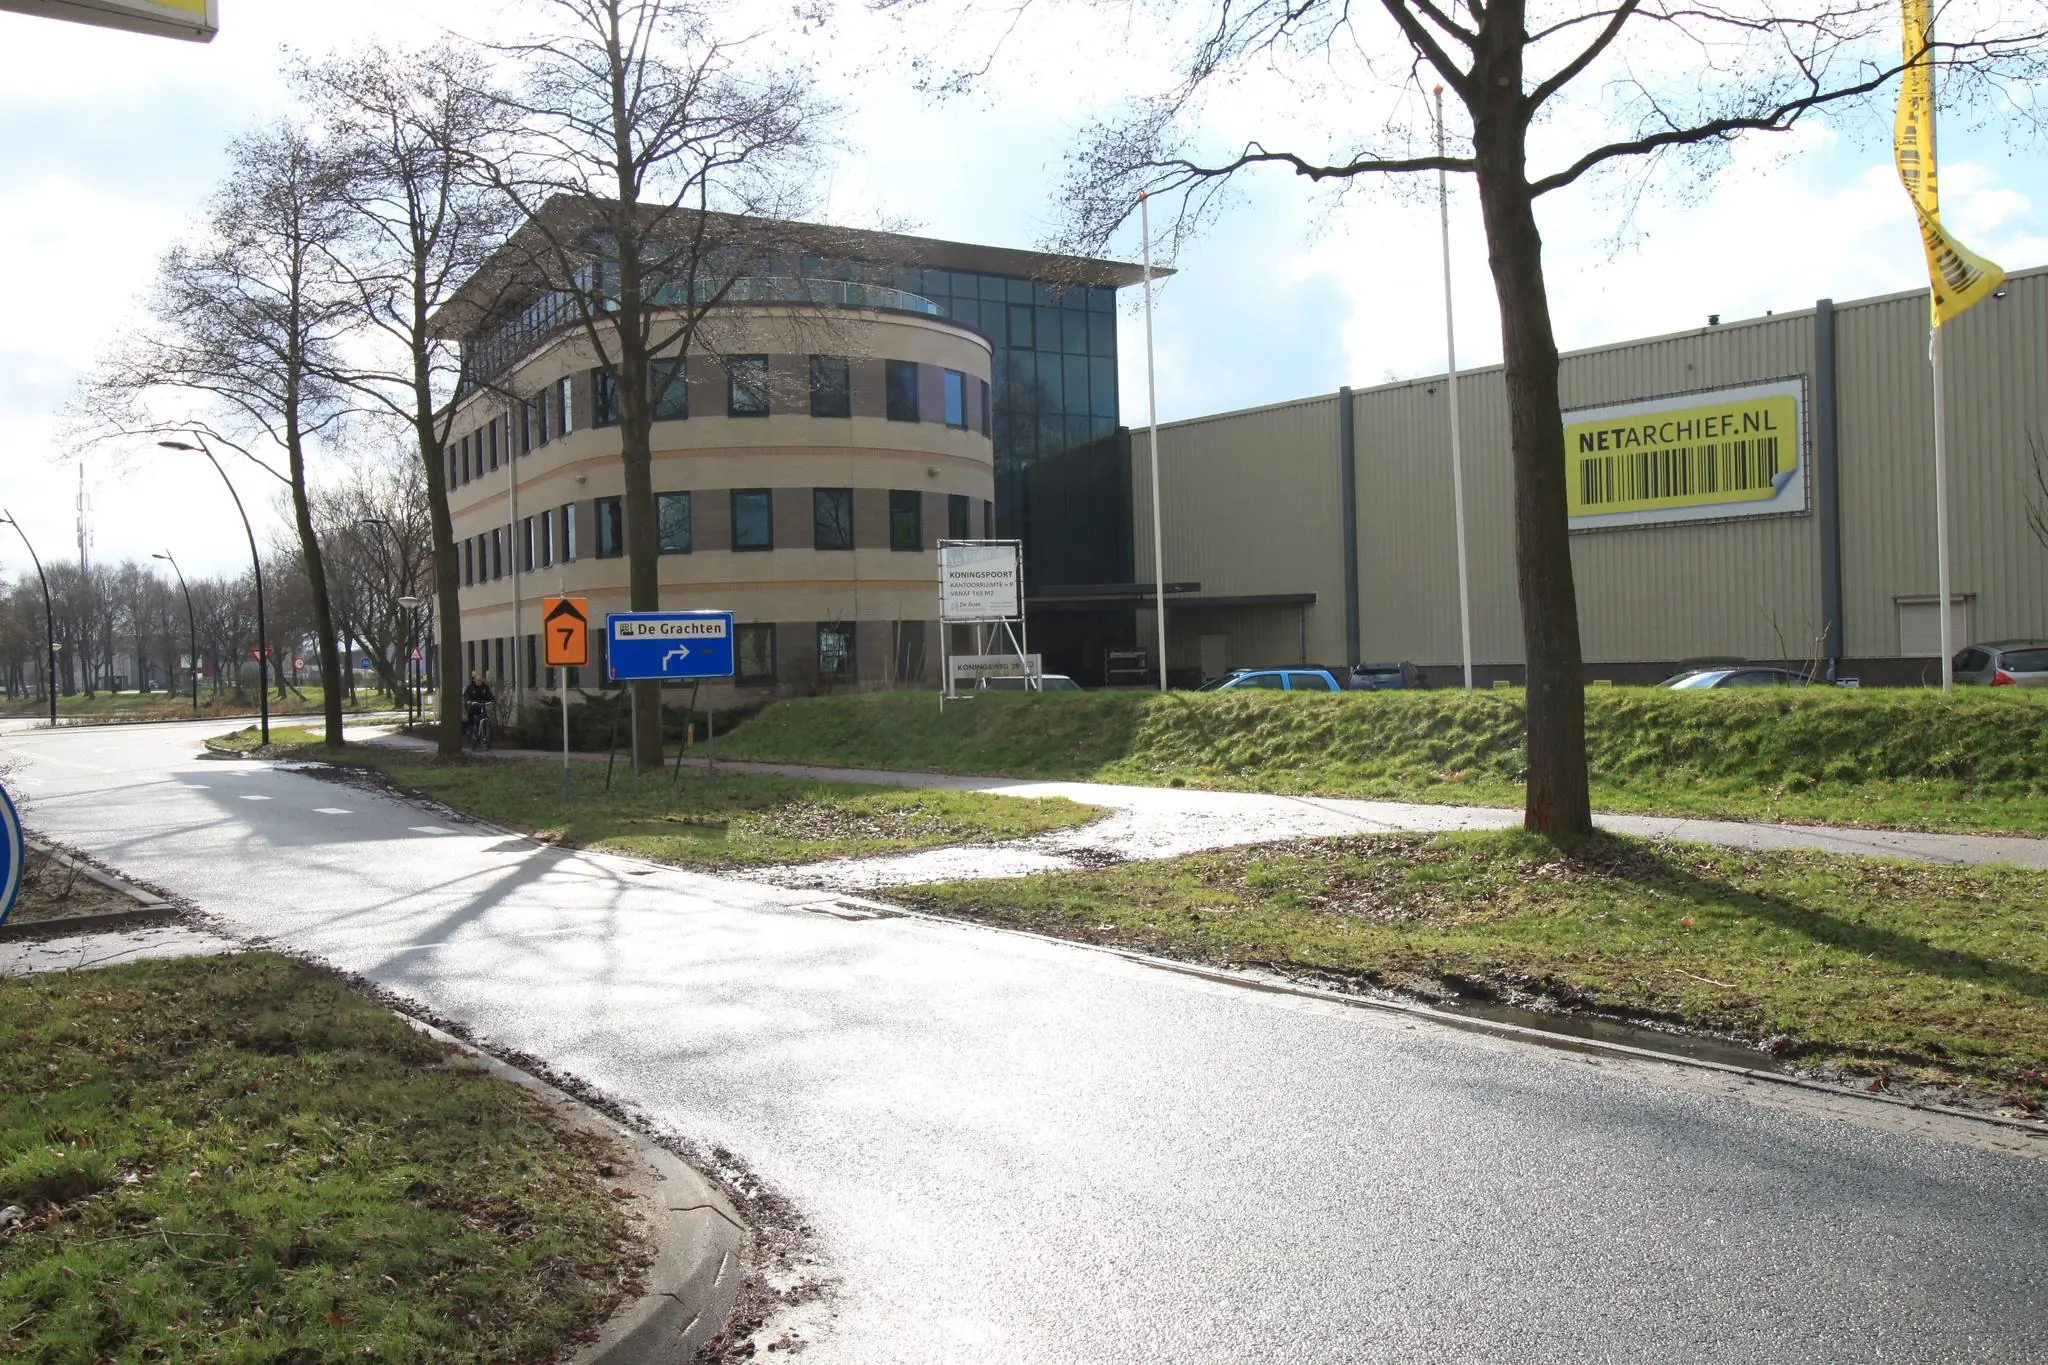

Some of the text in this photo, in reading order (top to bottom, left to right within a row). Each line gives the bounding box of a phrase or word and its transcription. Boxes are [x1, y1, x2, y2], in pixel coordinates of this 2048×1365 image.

[1578, 409, 1778, 454] NETARCHIEF.NL
[949, 571, 1013, 579] KONINGSPOORT
[637, 622, 722, 636] De Grachten
[556, 628, 575, 651] 7
[957, 663, 1009, 671] KONINGSWEG
